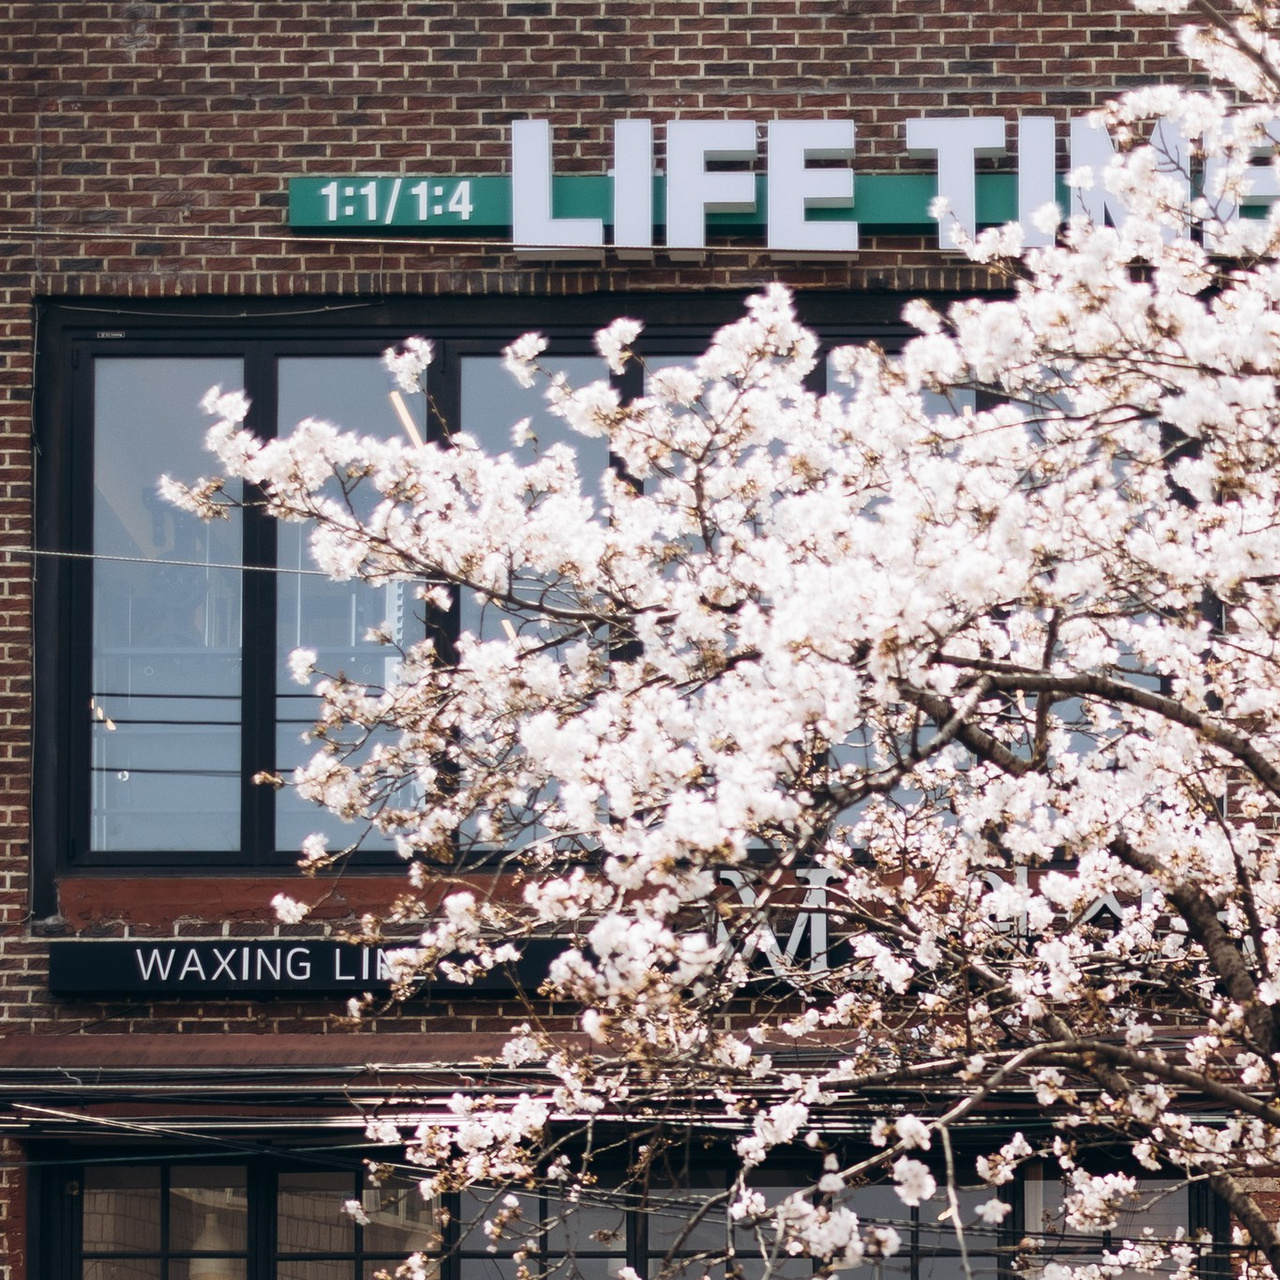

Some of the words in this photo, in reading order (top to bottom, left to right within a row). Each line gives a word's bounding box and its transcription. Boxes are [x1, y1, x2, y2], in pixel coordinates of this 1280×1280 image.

[321, 179, 473, 224] 1:1/1:4
[512, 119, 859, 256] LIFE
[136, 947, 311, 981] WAXING
